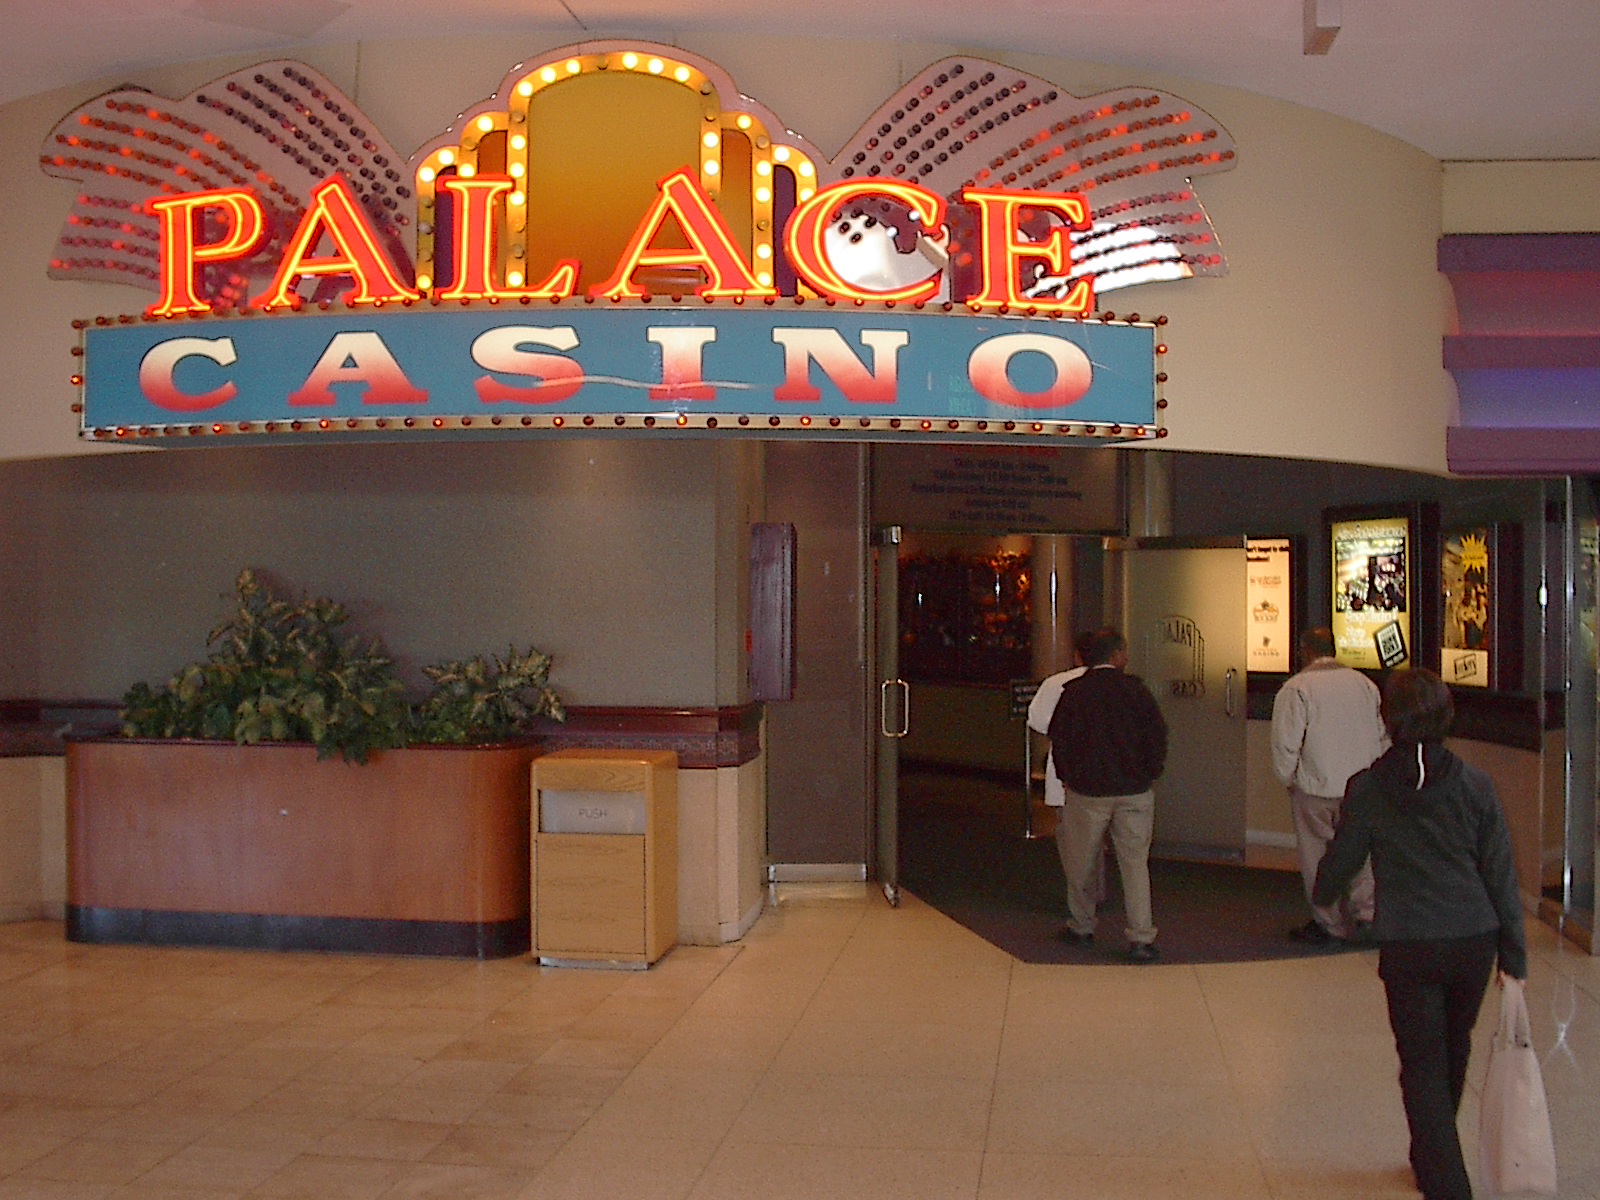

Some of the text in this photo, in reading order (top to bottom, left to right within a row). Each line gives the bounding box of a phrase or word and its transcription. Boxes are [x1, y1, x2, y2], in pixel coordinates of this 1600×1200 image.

[146, 170, 1096, 317] PALACE
[138, 324, 1094, 413] CASINO
[579, 808, 607, 819] PUSH
